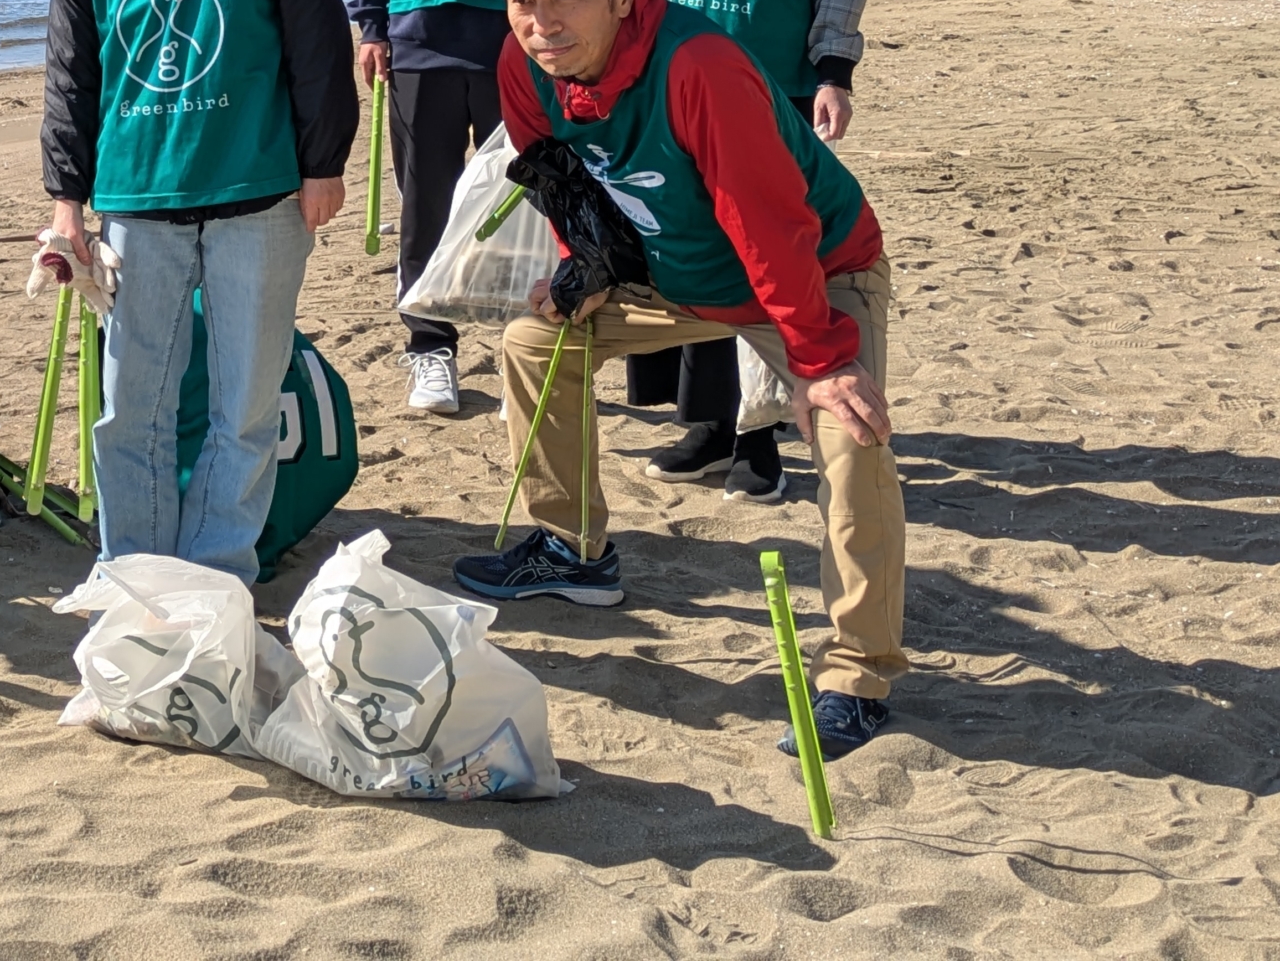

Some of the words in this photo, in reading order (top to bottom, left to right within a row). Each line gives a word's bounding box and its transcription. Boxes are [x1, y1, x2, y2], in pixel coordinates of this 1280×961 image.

[158, 40, 180, 82] g
[120, 100, 179, 118] green
[182, 93, 230, 113] bird
[329, 755, 395, 792] gree
[410, 755, 468, 791] bird
